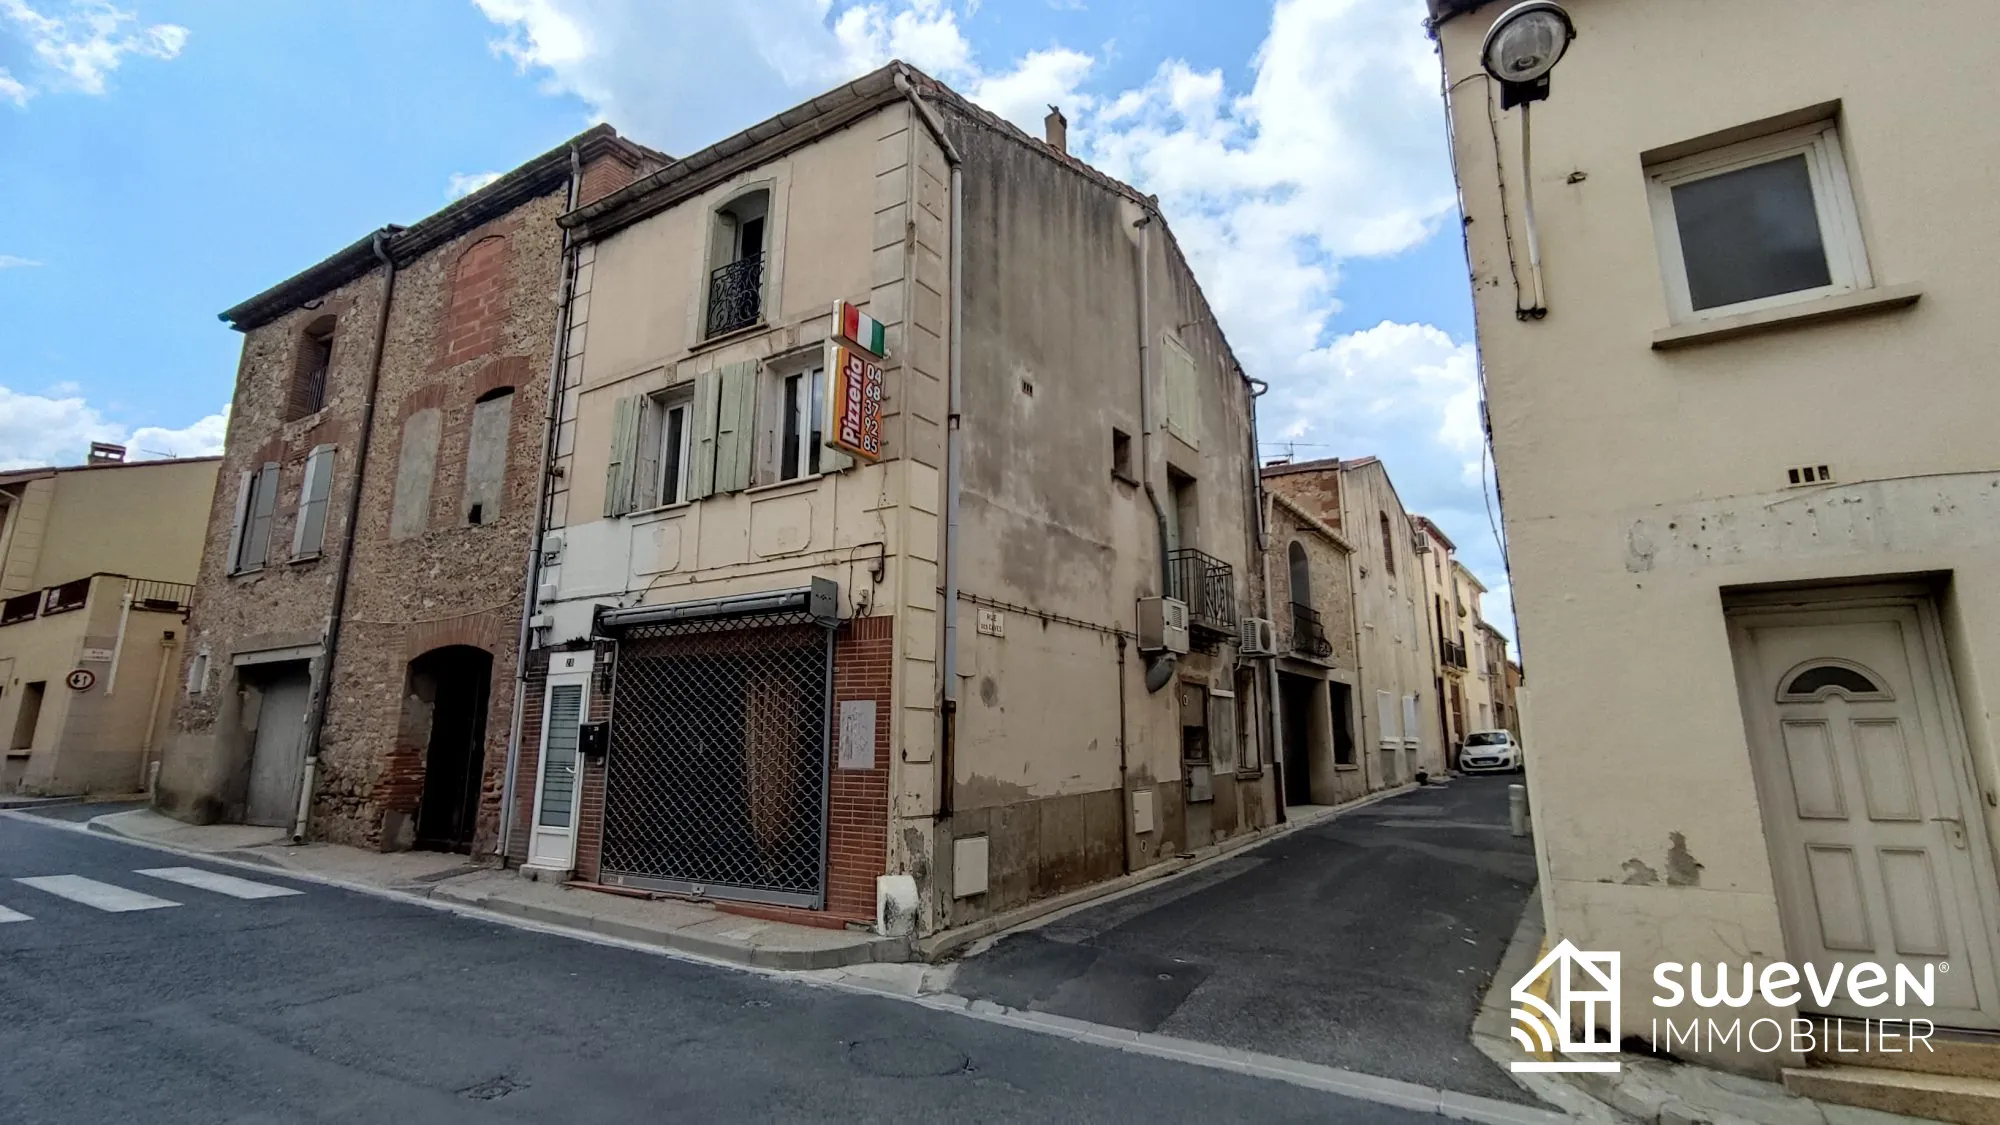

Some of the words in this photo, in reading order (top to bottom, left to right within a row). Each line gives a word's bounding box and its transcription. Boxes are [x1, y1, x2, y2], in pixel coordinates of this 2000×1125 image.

[866, 364, 882, 383] 04
[842, 356, 863, 446] Pizzeria
[865, 382, 881, 401] 68
[864, 400, 879, 417] 37
[864, 418, 879, 436] 92
[863, 435, 878, 454] 85
